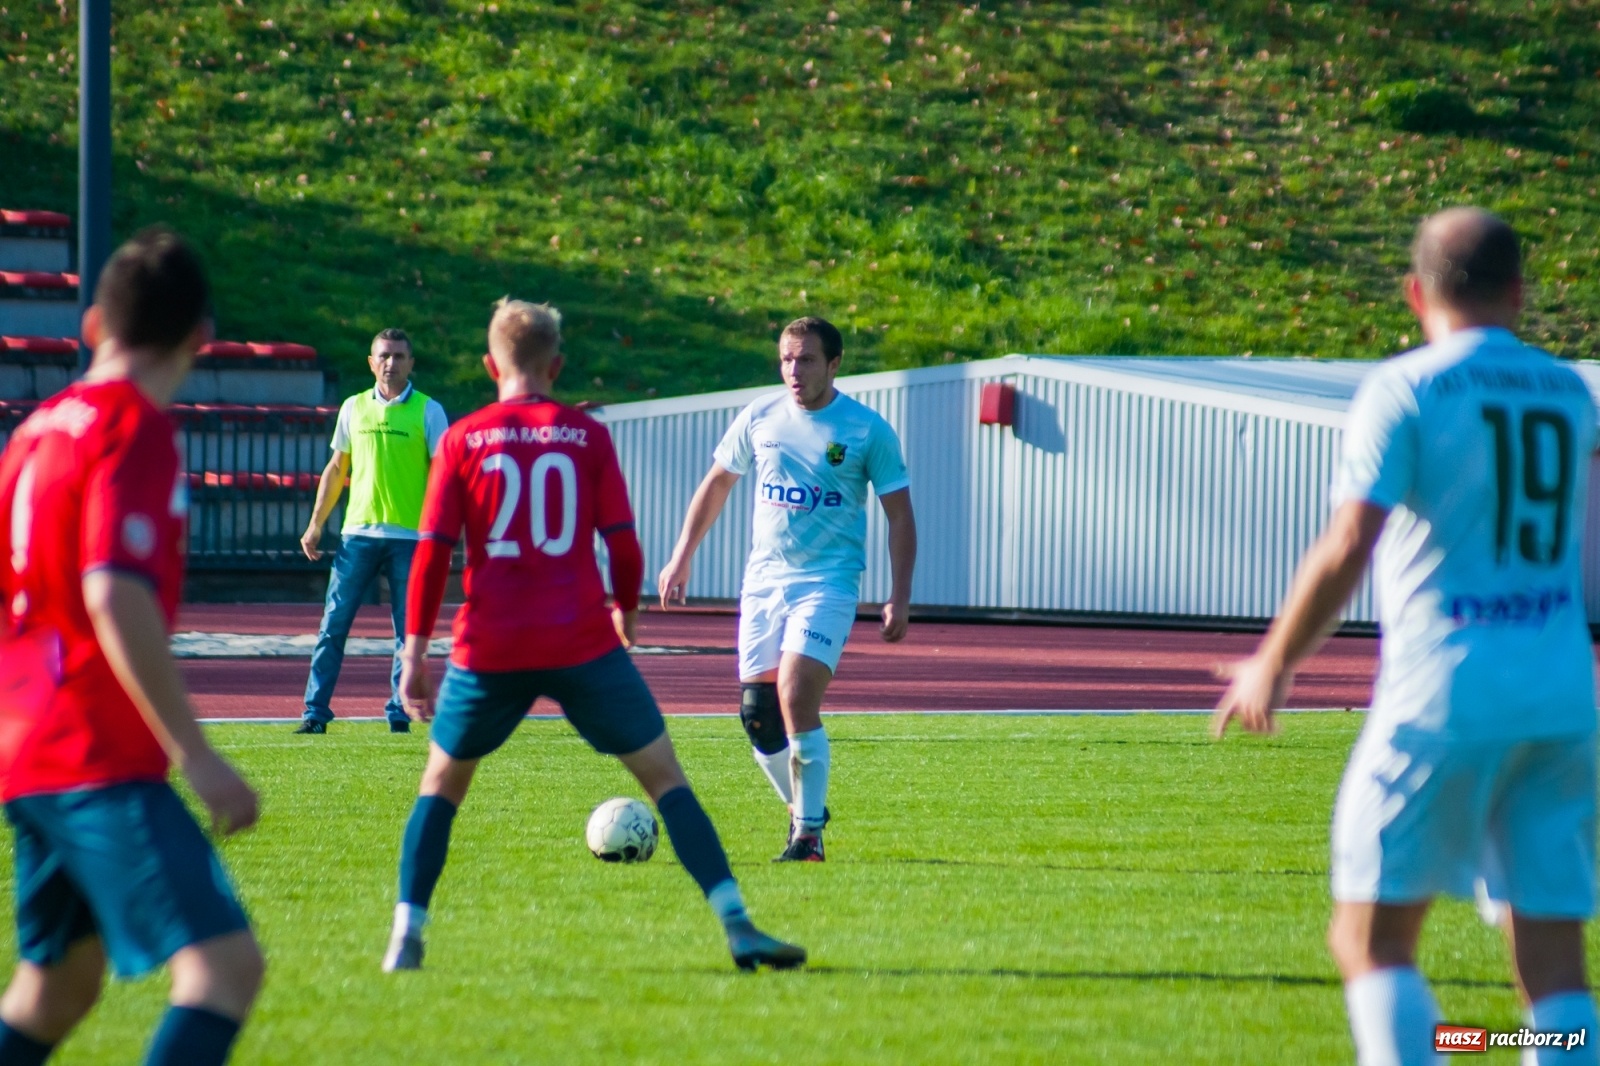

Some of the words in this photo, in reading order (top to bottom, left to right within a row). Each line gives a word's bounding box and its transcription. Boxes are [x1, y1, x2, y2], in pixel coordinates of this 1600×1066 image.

[483, 426, 519, 445] UNIA
[481, 452, 577, 559] 20
[761, 481, 842, 516] moya
[1480, 402, 1574, 567] 19
